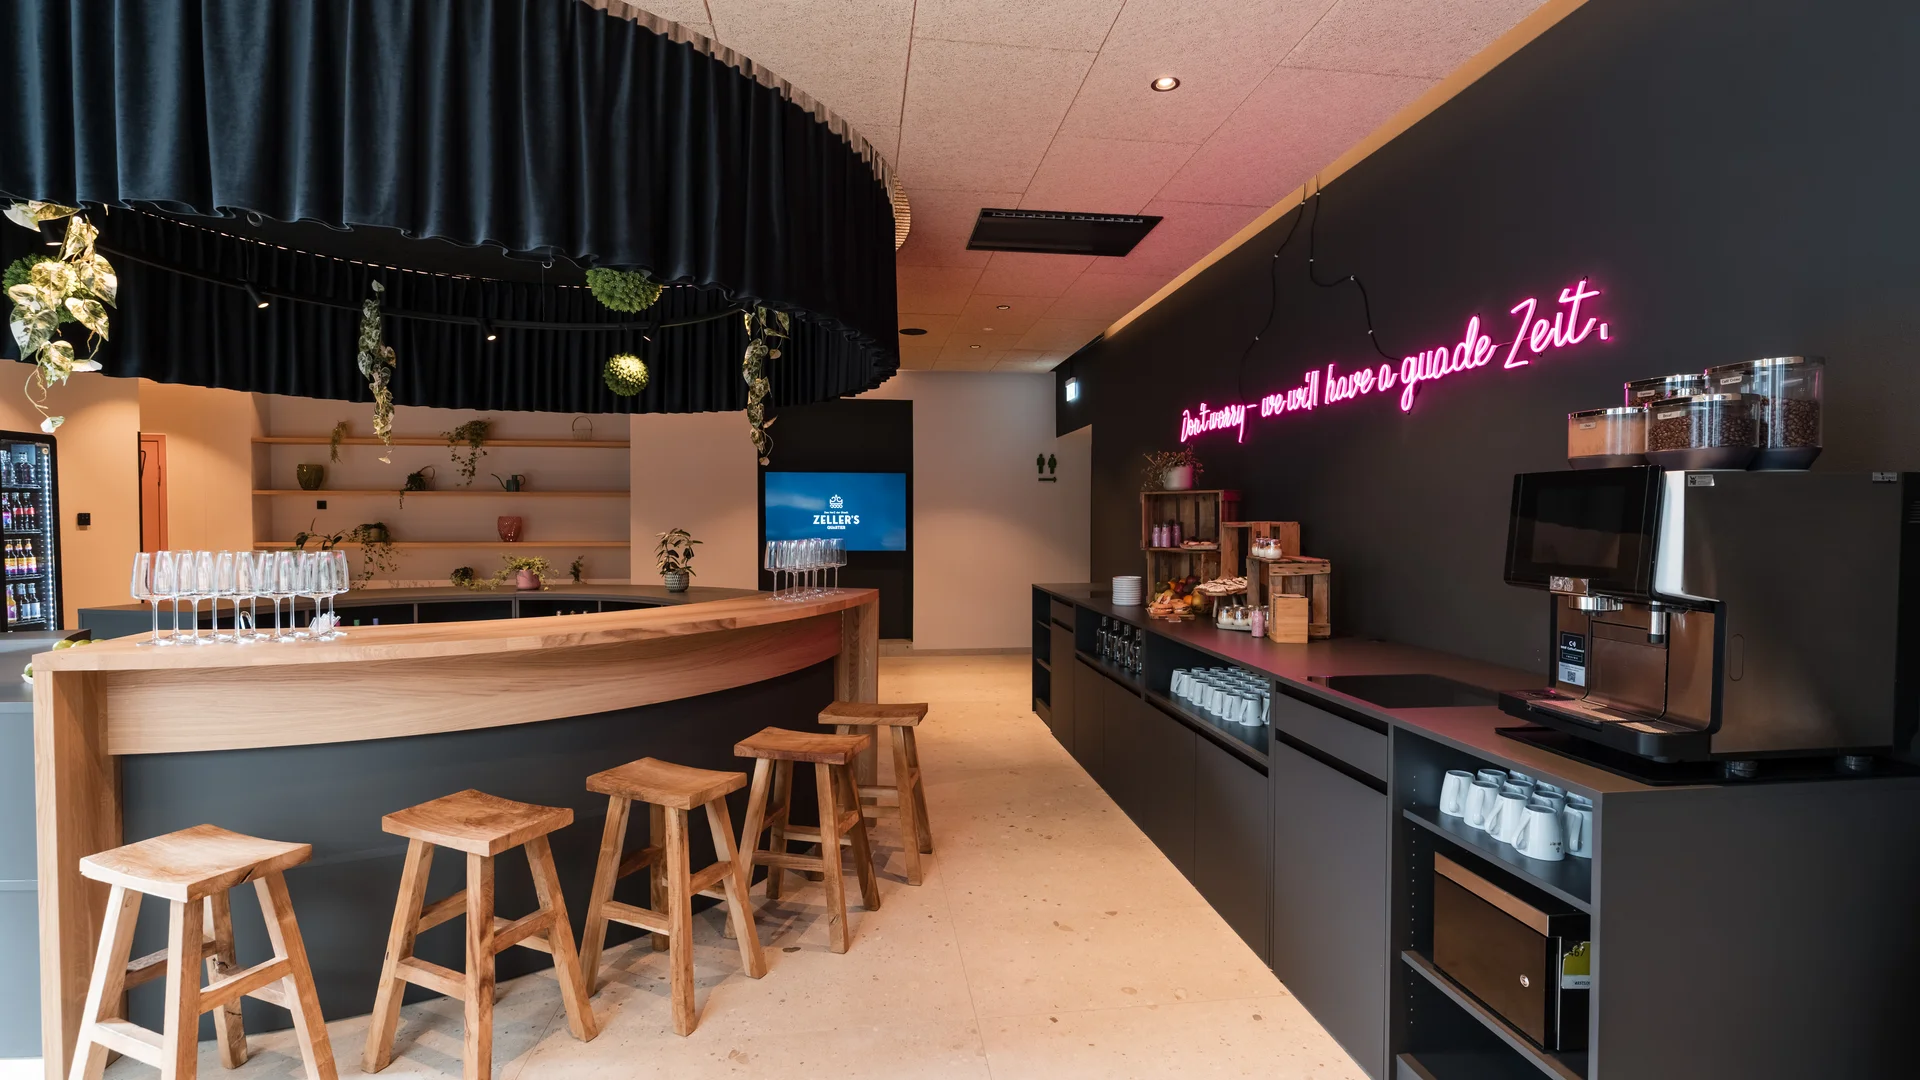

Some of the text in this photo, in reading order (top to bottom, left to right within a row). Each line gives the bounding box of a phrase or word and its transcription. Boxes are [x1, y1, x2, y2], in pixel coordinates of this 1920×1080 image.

[1181, 403, 1210, 442] Don't
[1209, 405, 1246, 443] worry
[1262, 394, 1287, 417] we
[1287, 370, 1320, 410] will
[1324, 363, 1377, 404] have
[1378, 364, 1399, 391] a
[1400, 315, 1498, 411] guade
[813, 515, 860, 524] ZELLER'S
